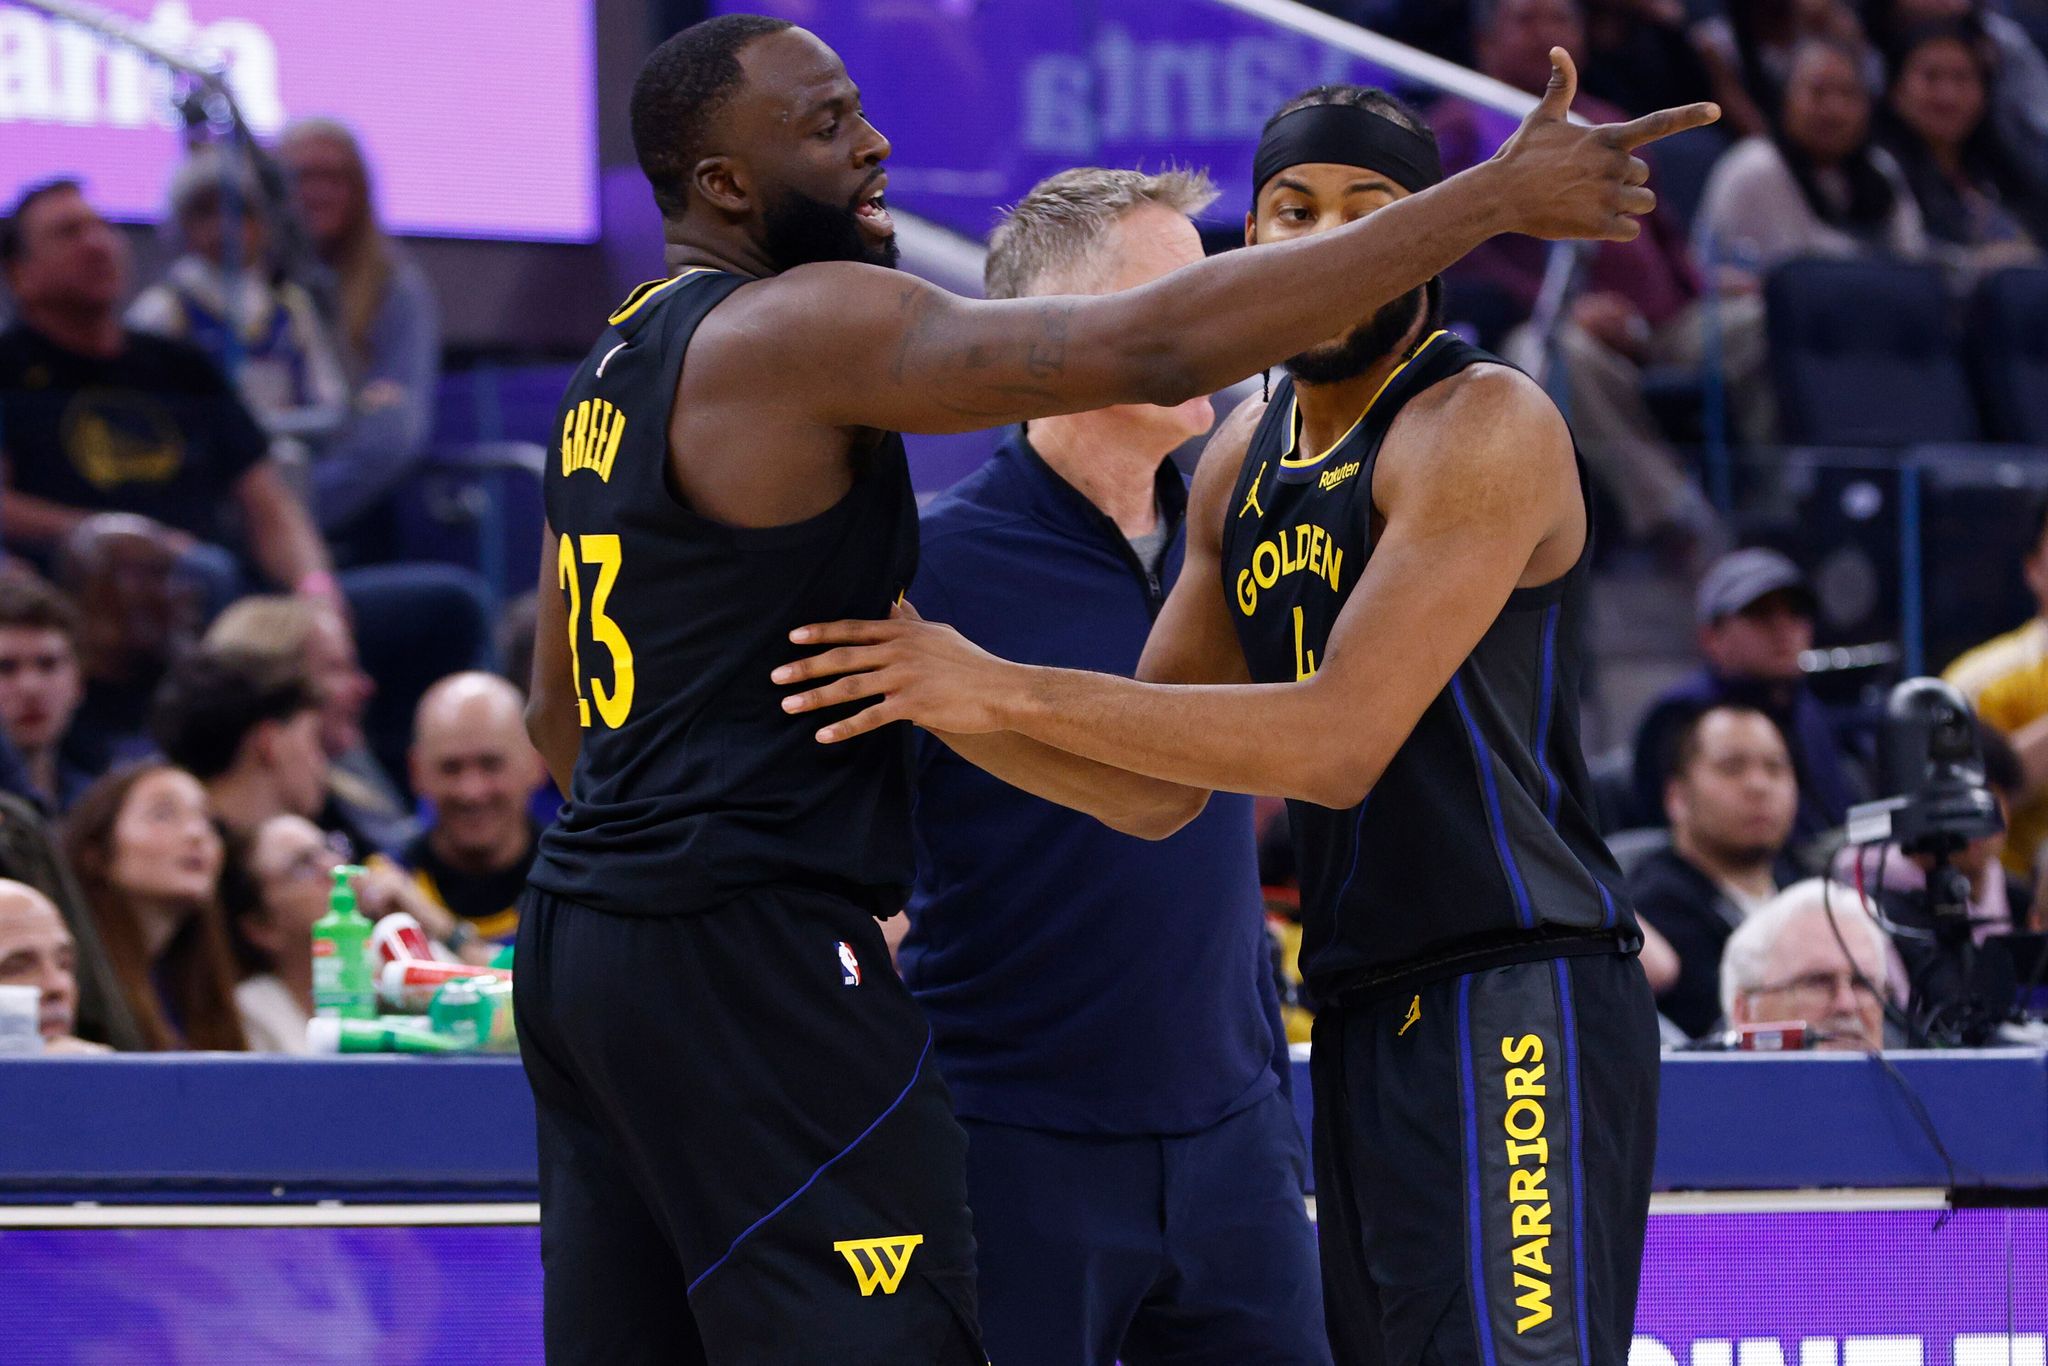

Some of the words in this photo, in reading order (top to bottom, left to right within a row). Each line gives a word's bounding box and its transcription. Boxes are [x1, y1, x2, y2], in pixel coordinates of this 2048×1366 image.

[561, 397, 627, 484] GREEN
[1318, 461, 1360, 491] Rakuten
[1236, 523, 1344, 617] GOLDEN
[558, 532, 635, 730] 23
[1501, 1033, 1553, 1335] WARRIORS
